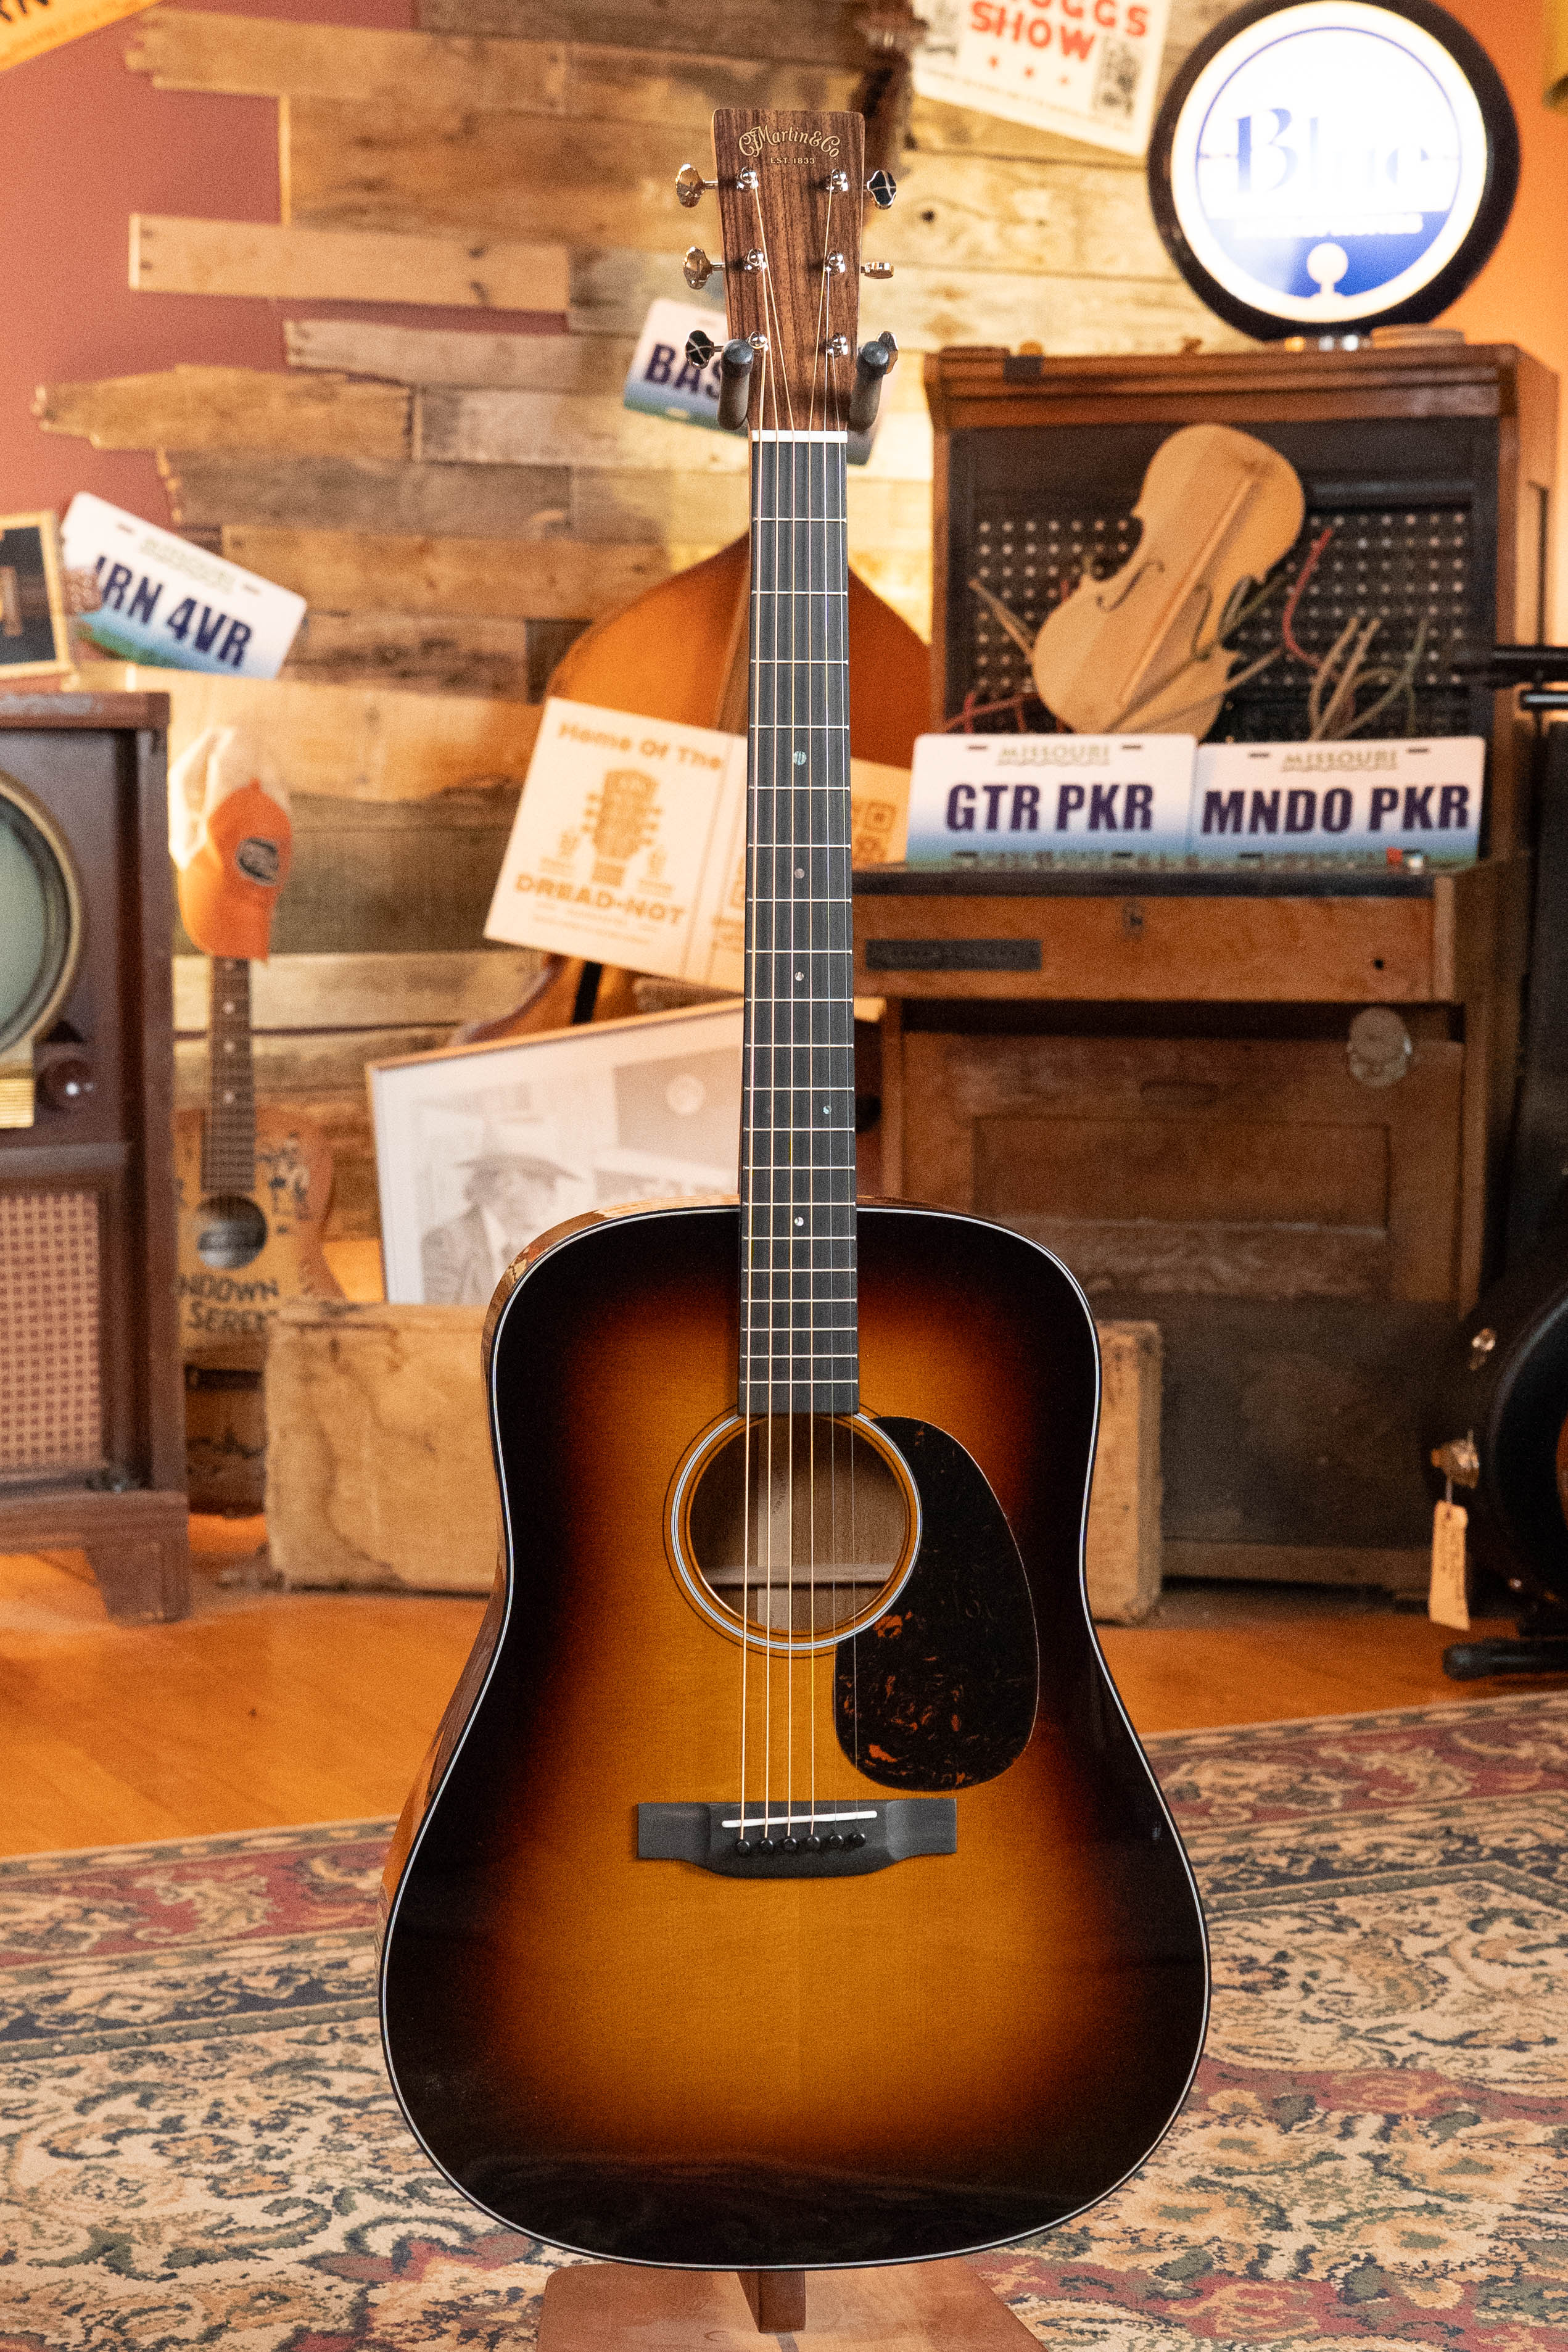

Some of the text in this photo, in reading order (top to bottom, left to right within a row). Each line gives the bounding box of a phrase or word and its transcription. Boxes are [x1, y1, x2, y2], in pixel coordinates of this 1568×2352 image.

[971, 0, 1096, 60] SHOW
[95, 555, 163, 625] RN
[167, 596, 254, 668] 4VR
[558, 721, 723, 770] Home Of The
[997, 743, 1110, 764] MISSOURI
[1282, 749, 1398, 770] MISSOURI
[946, 783, 1154, 831] GTR PKR
[1201, 785, 1470, 835] MNDO PKR
[514, 872, 685, 926] DREAD-NOT
